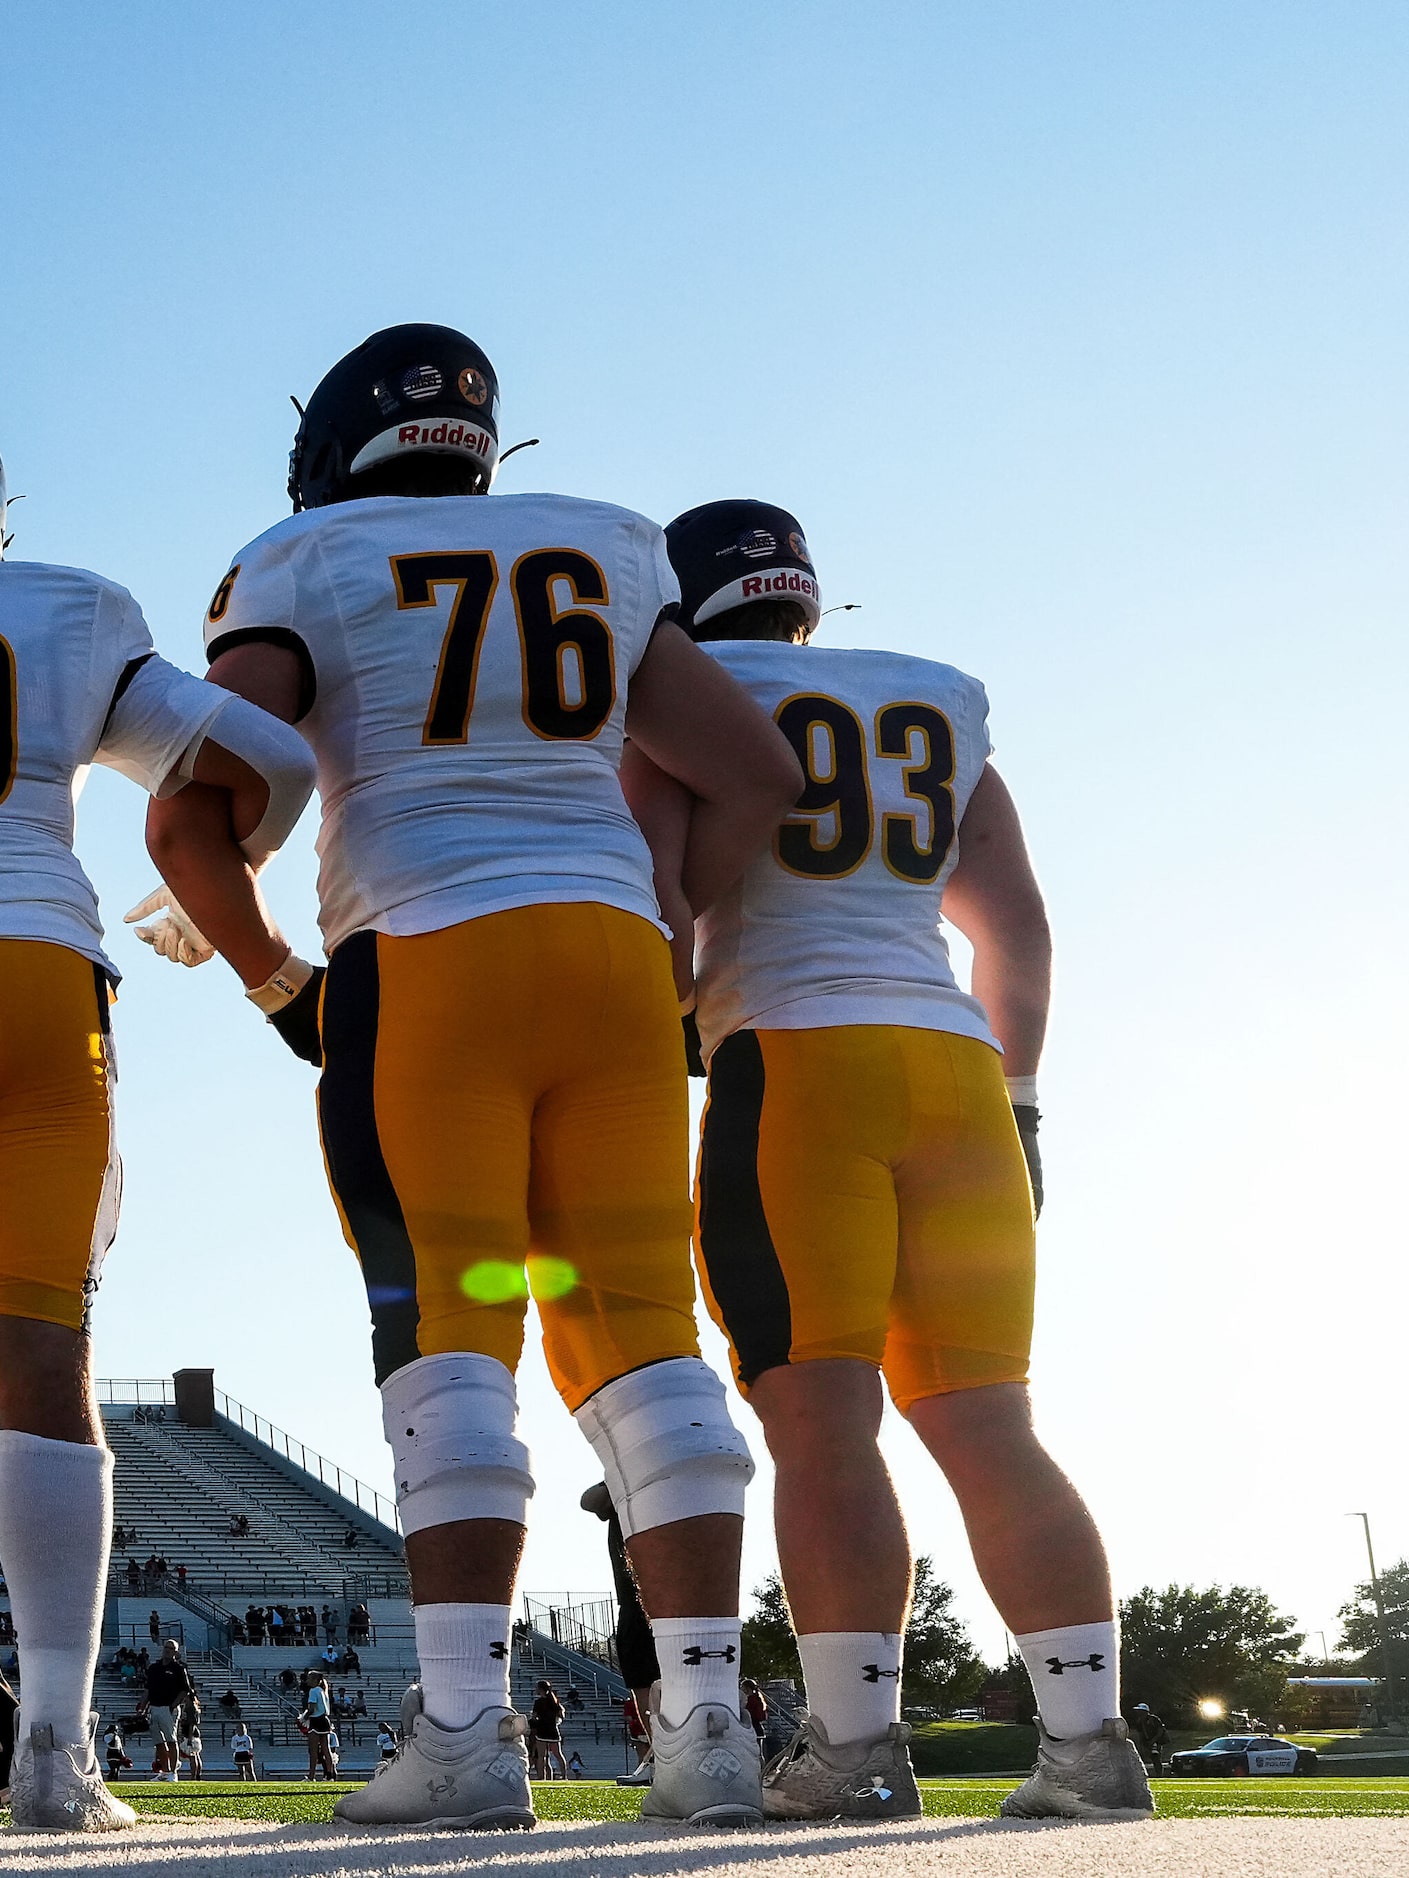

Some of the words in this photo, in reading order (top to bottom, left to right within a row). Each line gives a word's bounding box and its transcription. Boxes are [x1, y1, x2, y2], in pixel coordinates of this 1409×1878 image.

[398, 423, 490, 457] Riddell
[389, 547, 617, 746] 76
[771, 691, 957, 886] 93
